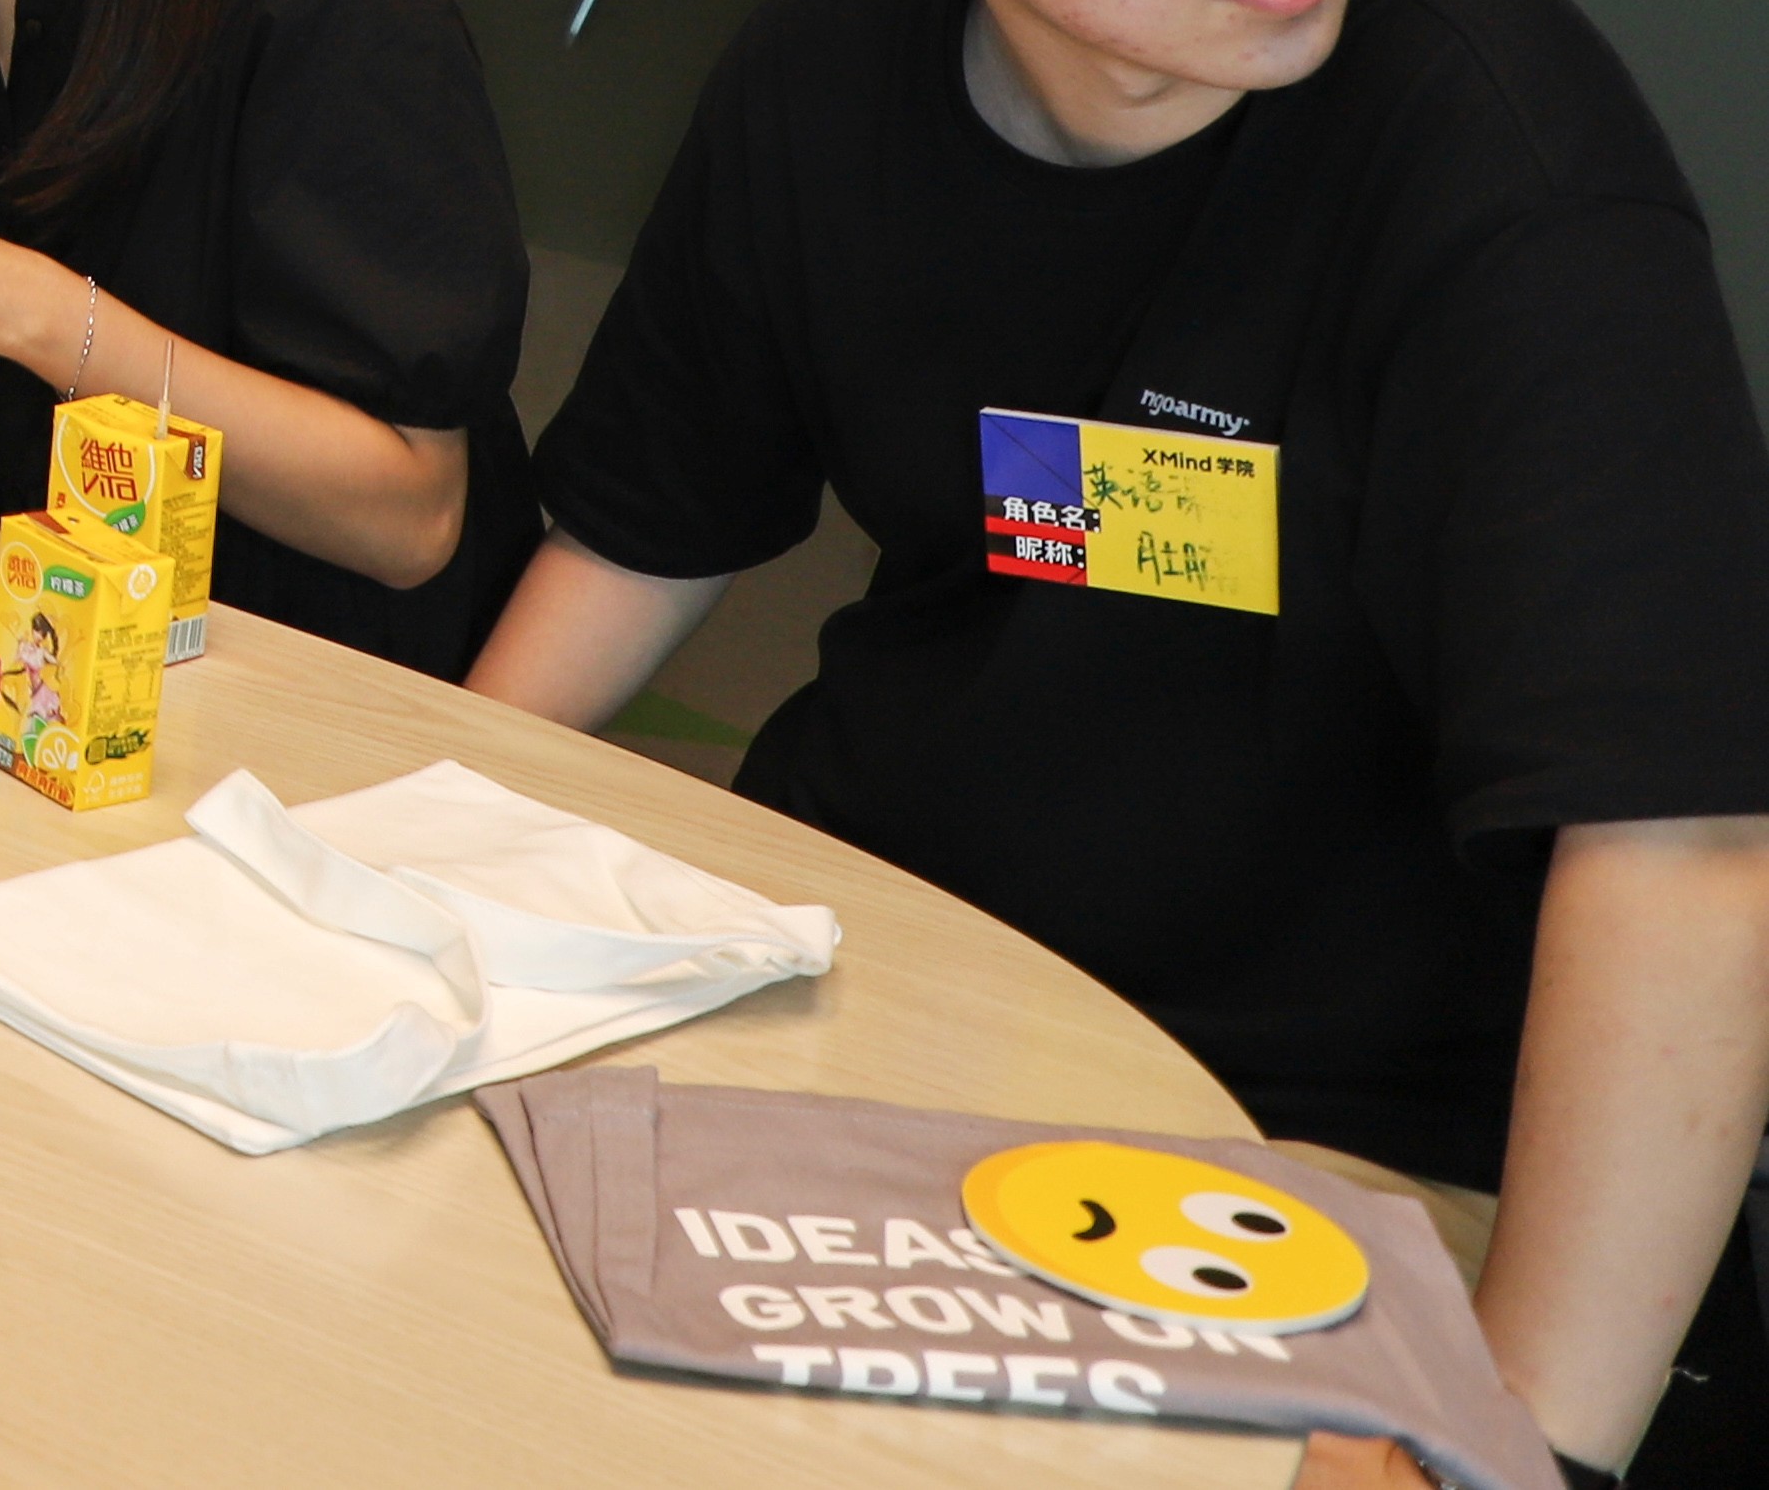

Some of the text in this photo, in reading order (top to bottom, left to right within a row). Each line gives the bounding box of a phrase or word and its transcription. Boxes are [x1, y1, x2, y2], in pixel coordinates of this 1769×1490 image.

[1140, 388, 1245, 437] ngoarmy
[1141, 448, 1256, 479] XMind 学院
[718, 1283, 1076, 1343] GROW
